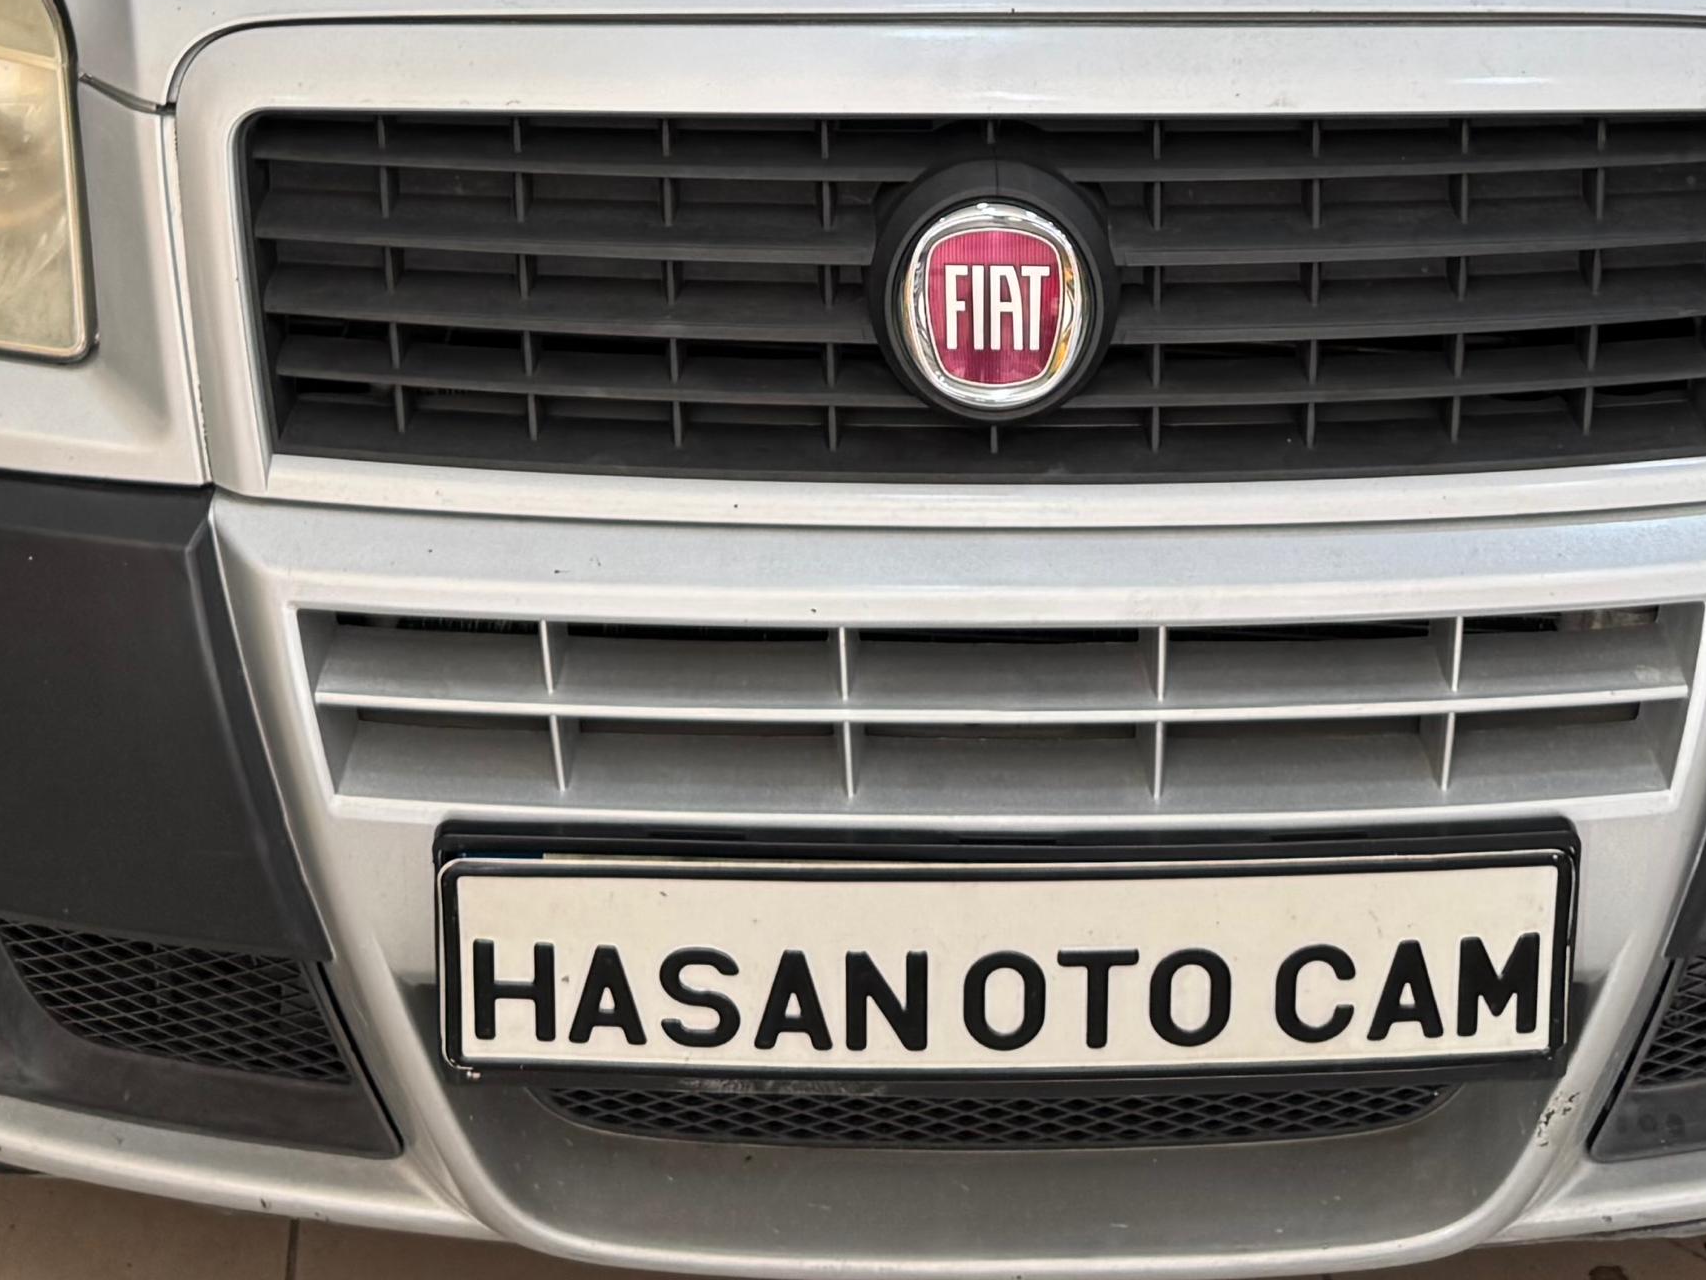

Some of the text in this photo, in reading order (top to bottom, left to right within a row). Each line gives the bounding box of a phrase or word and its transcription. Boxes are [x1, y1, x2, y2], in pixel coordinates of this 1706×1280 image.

[944, 264, 1051, 352] FIAT
[472, 932, 1541, 1052] HASAN OTO CAM
